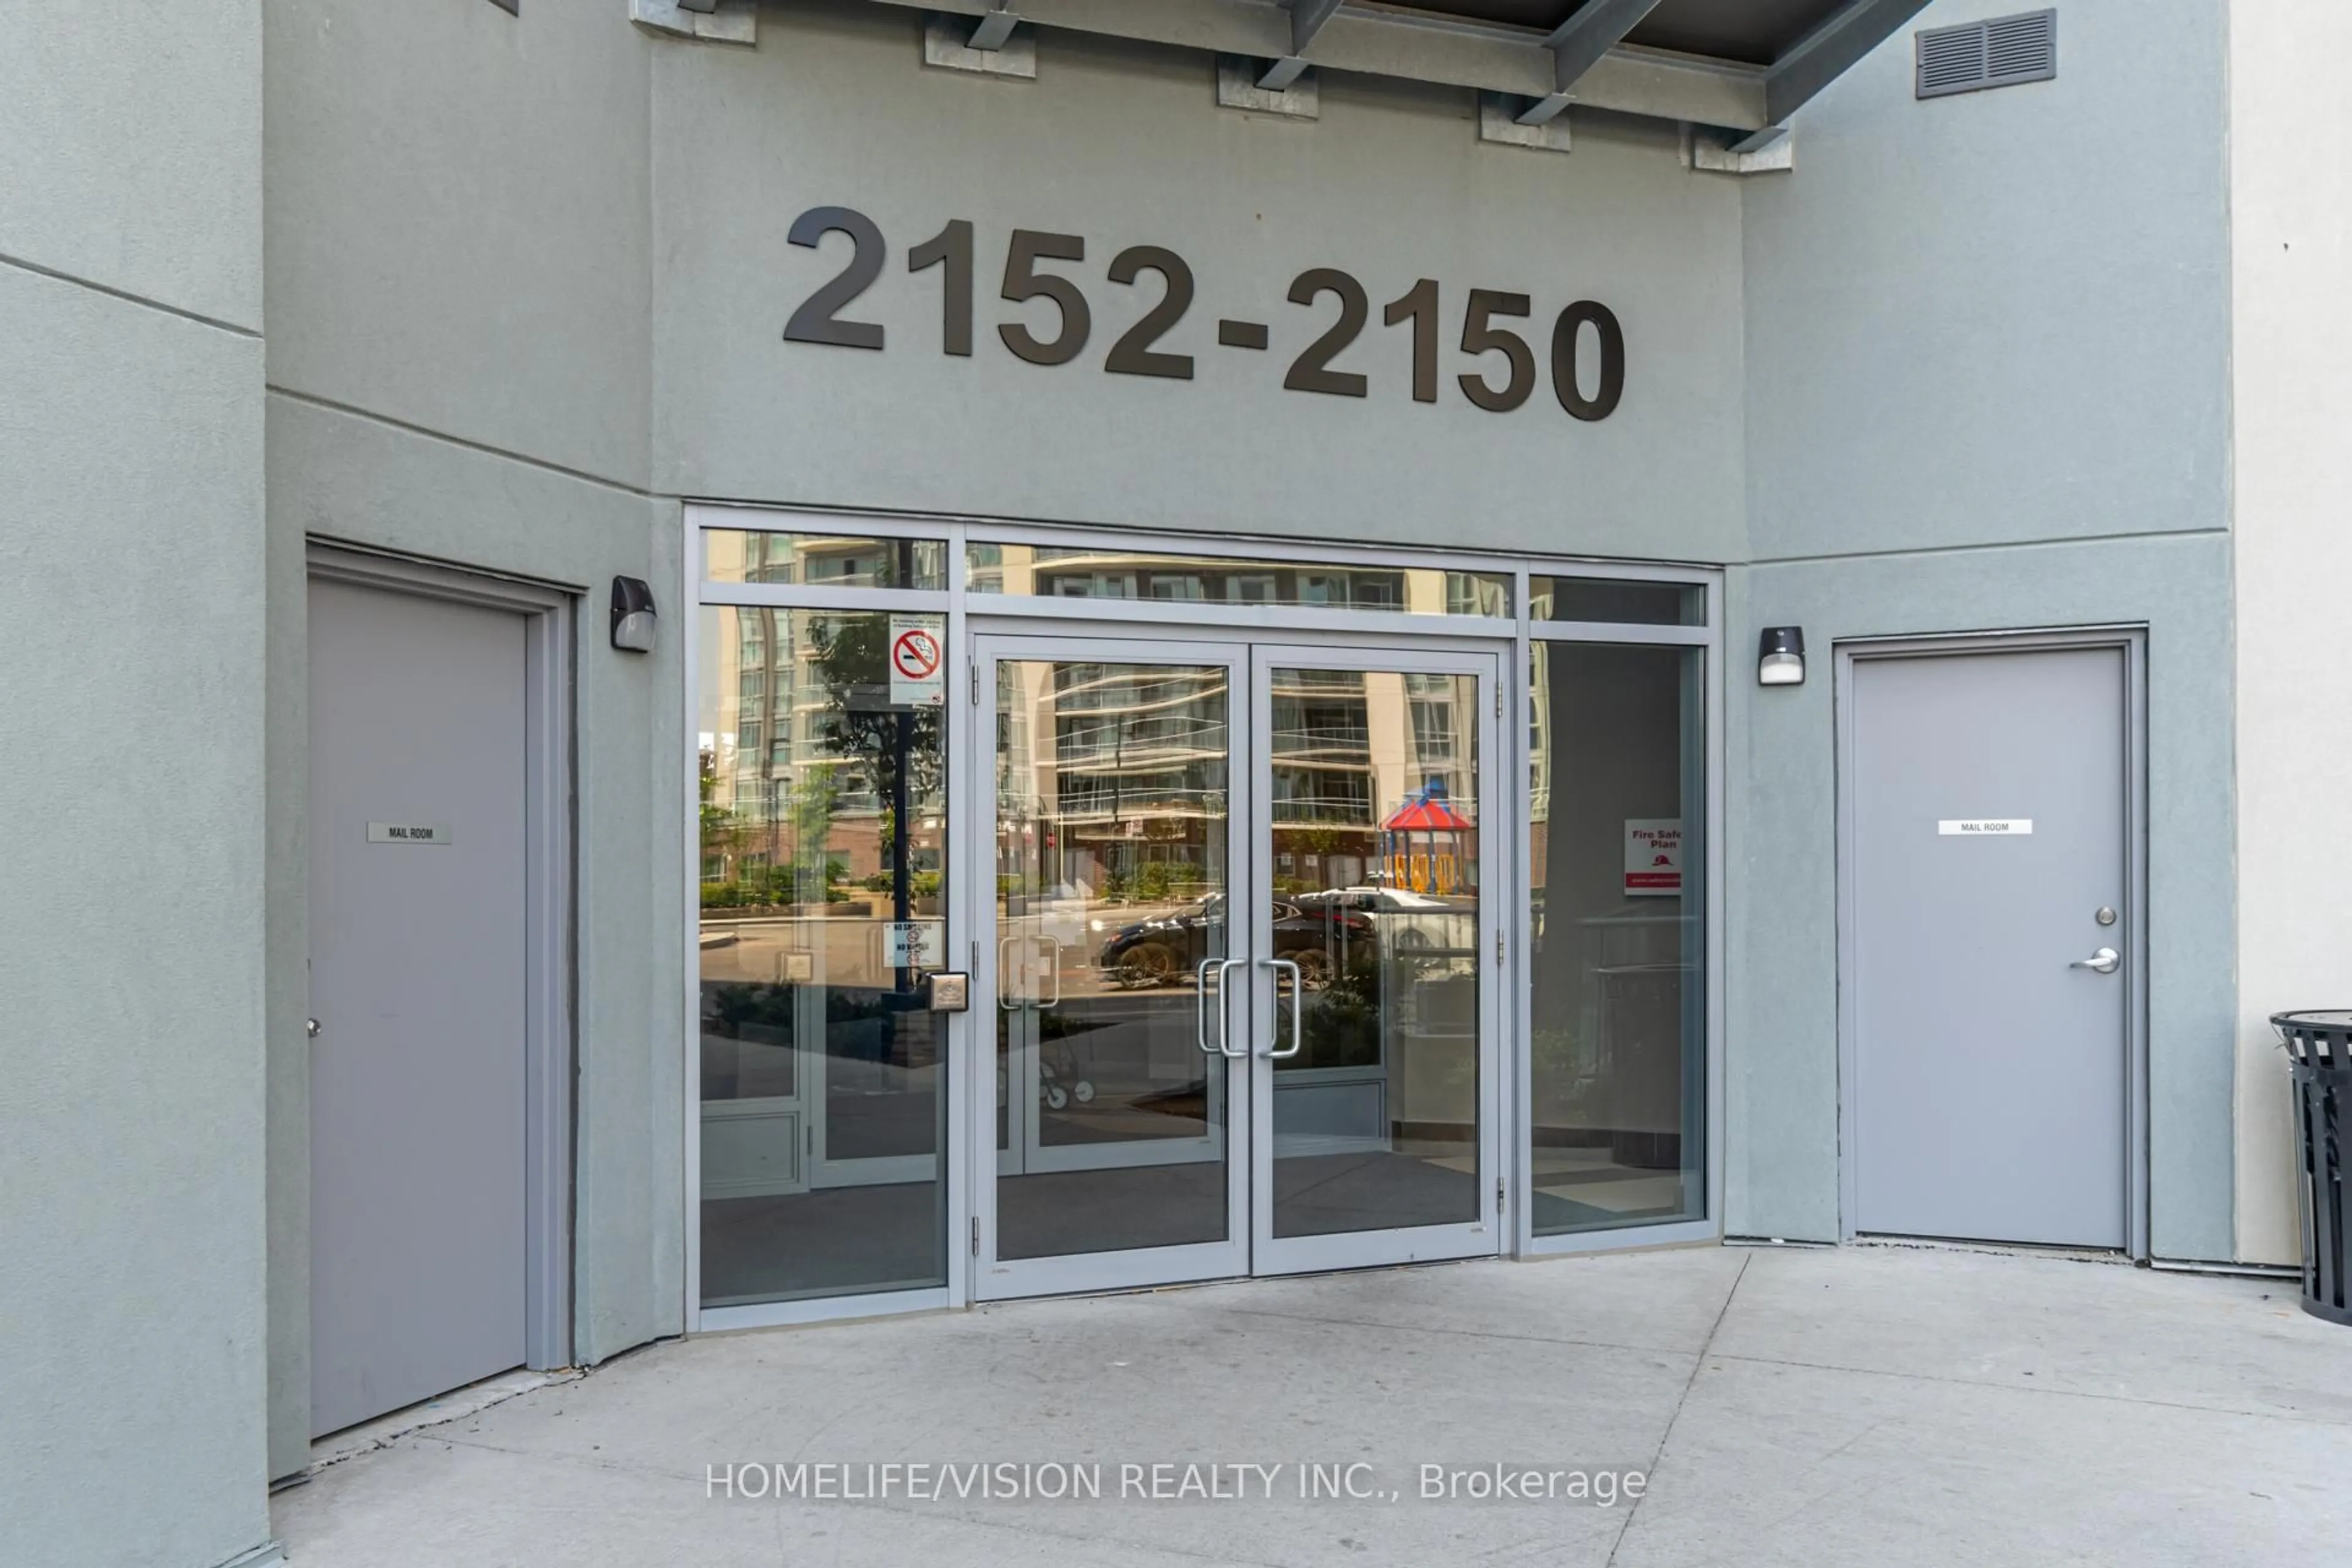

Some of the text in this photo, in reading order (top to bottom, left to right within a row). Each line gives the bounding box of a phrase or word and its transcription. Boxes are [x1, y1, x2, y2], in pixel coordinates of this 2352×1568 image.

[783, 205, 1625, 422] 2152-2150
[389, 827, 433, 839] MAIL ROOM
[1632, 830, 1654, 839] Fire
[1651, 840, 1676, 848] Plan
